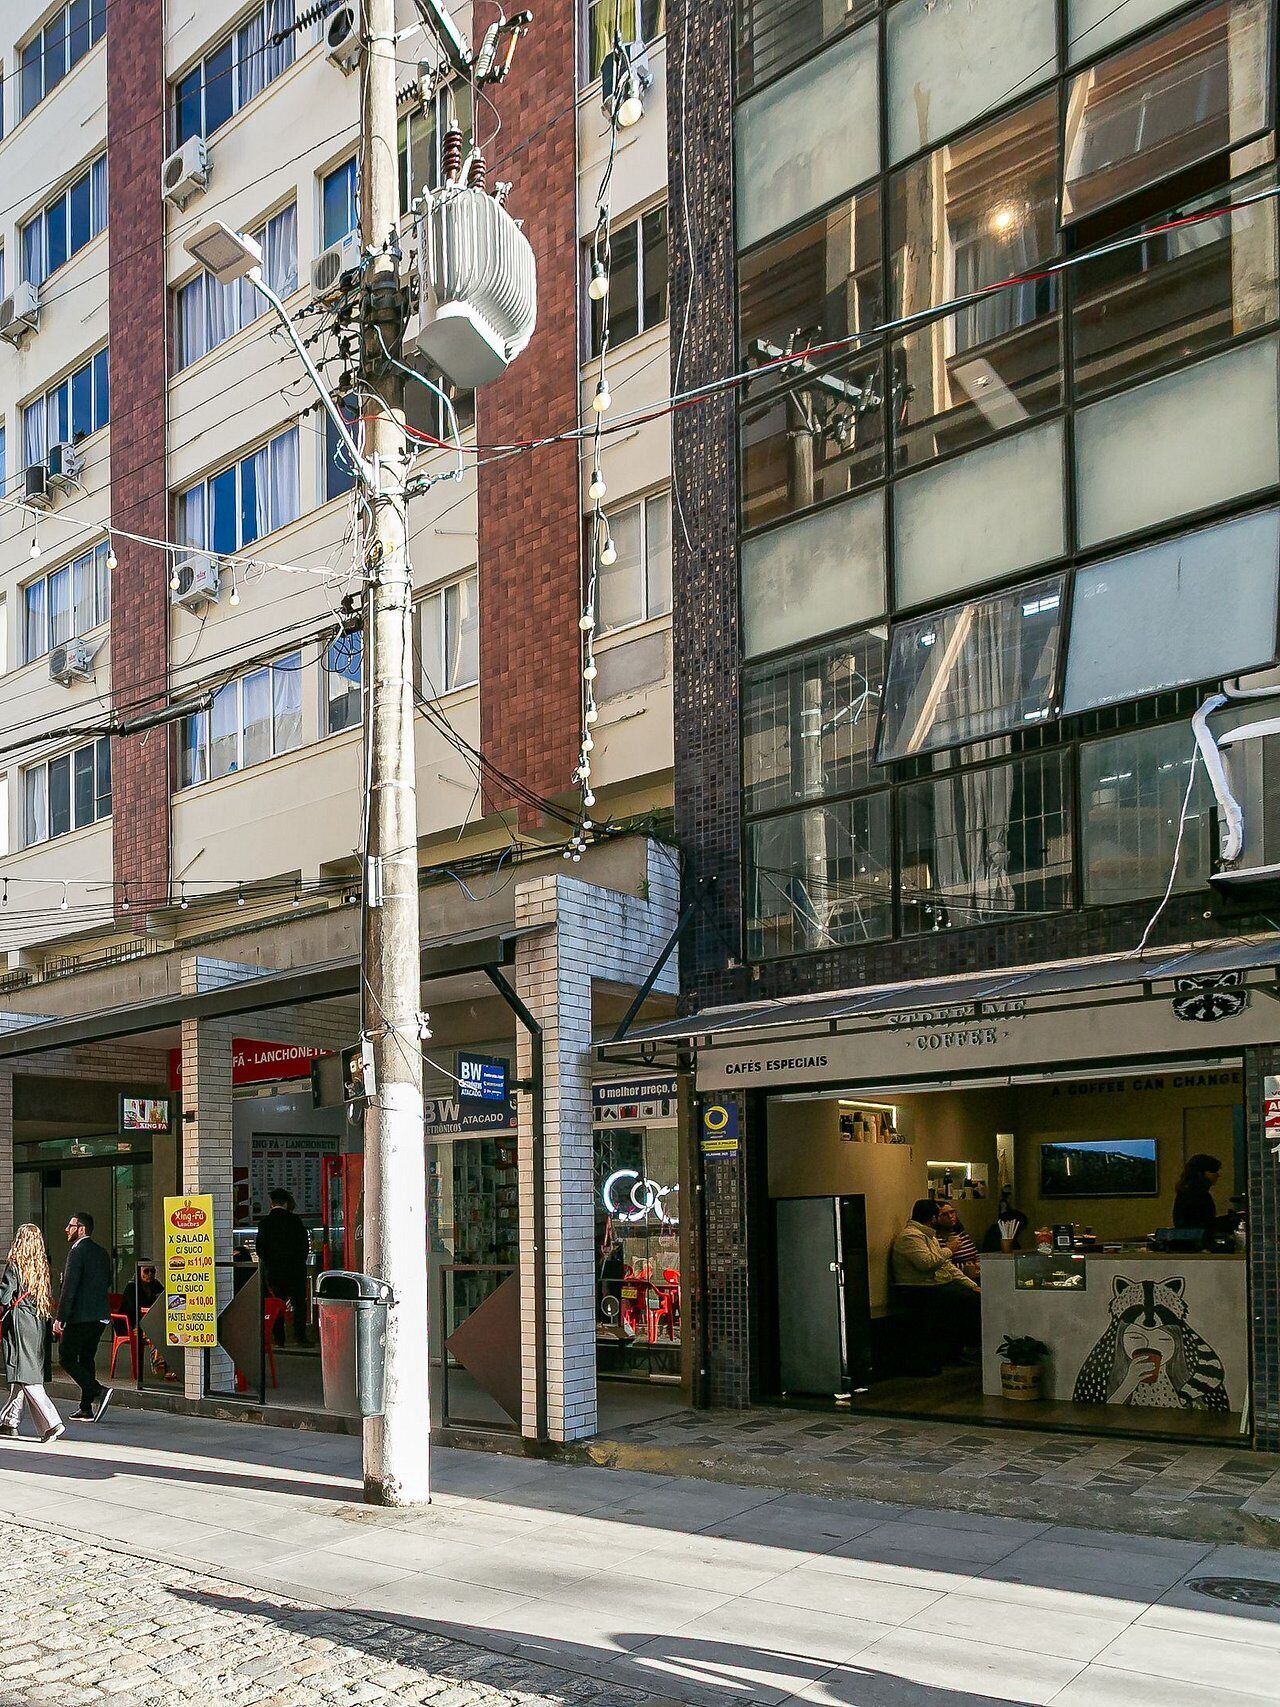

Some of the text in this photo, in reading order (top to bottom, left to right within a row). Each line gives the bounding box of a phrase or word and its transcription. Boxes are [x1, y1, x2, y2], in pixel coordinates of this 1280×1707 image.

[915, 1027, 998, 1051] COFFEE
[725, 1055, 828, 1075] CAFÉS ESPECIAIS
[461, 1061, 482, 1081] BW
[1051, 1072, 1240, 1097] A COFFEE CAN CHANGE
[599, 1088, 606, 1099] O
[607, 1086, 639, 1098] melhor
[641, 1084, 670, 1097] preço,
[423, 1099, 460, 1123] BW
[462, 1113, 504, 1125] ATACADO
[168, 1233, 210, 1244] X SALADA
[175, 1245, 203, 1254] C/ SUCO
[194, 1256, 213, 1268] 11,00
[170, 1272, 210, 1282] CALZONE
[176, 1284, 204, 1293] C/ SUCO
[196, 1296, 214, 1307] 10,00
[167, 1312, 187, 1322] PASTEL
[191, 1312, 214, 1322] RISOLES
[177, 1323, 205, 1331] C/ SUCO
[200, 1333, 215, 1344] 8,00
